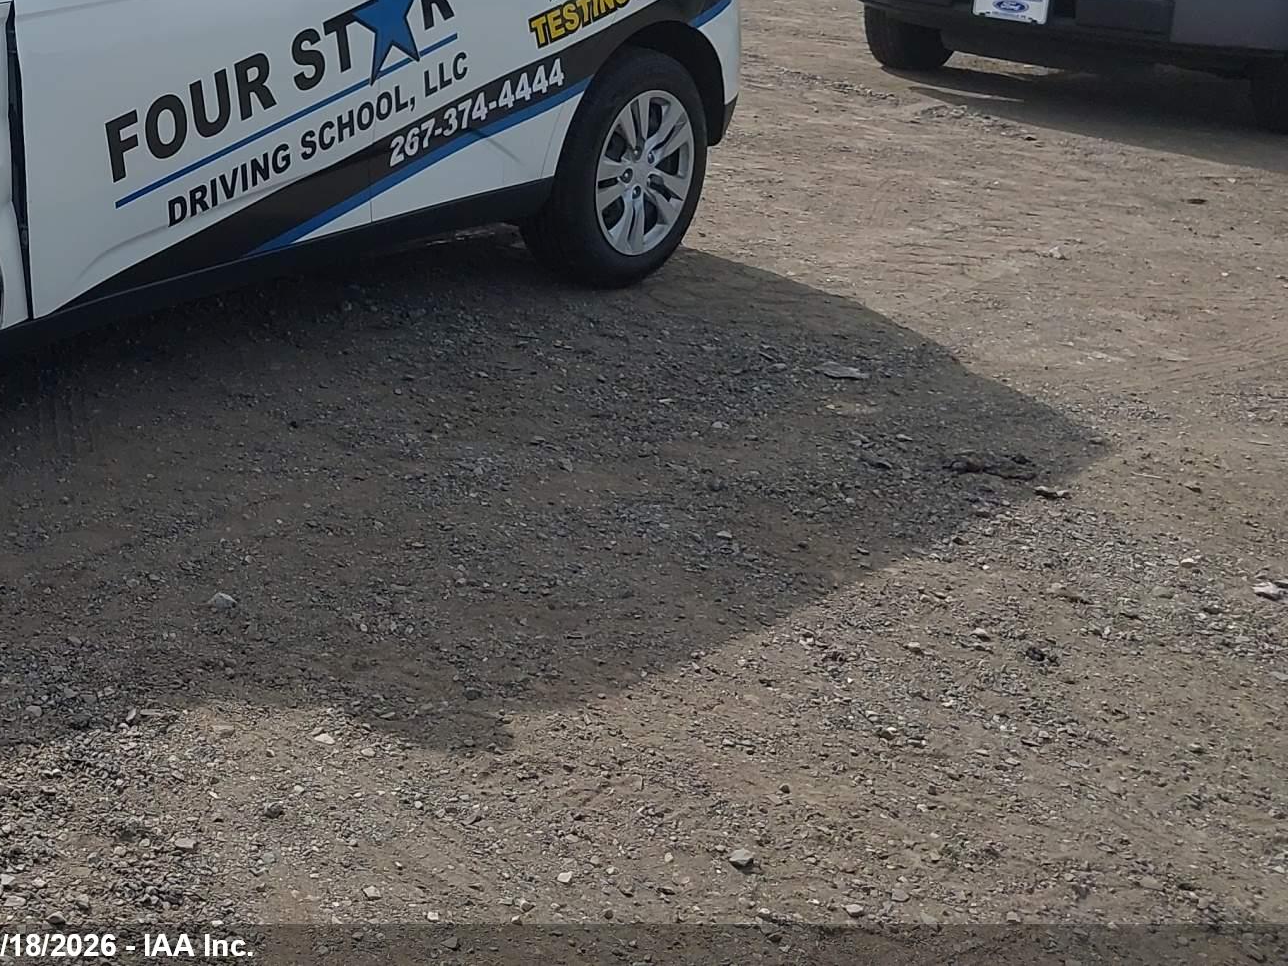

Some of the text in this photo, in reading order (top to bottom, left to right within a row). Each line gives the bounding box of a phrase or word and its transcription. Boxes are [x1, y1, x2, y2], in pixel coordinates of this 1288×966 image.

[105, 52, 277, 183] FOUR
[167, 52, 468, 228] DRIVING SCHOOL, LLC
[389, 58, 565, 167] 267-374-4444
